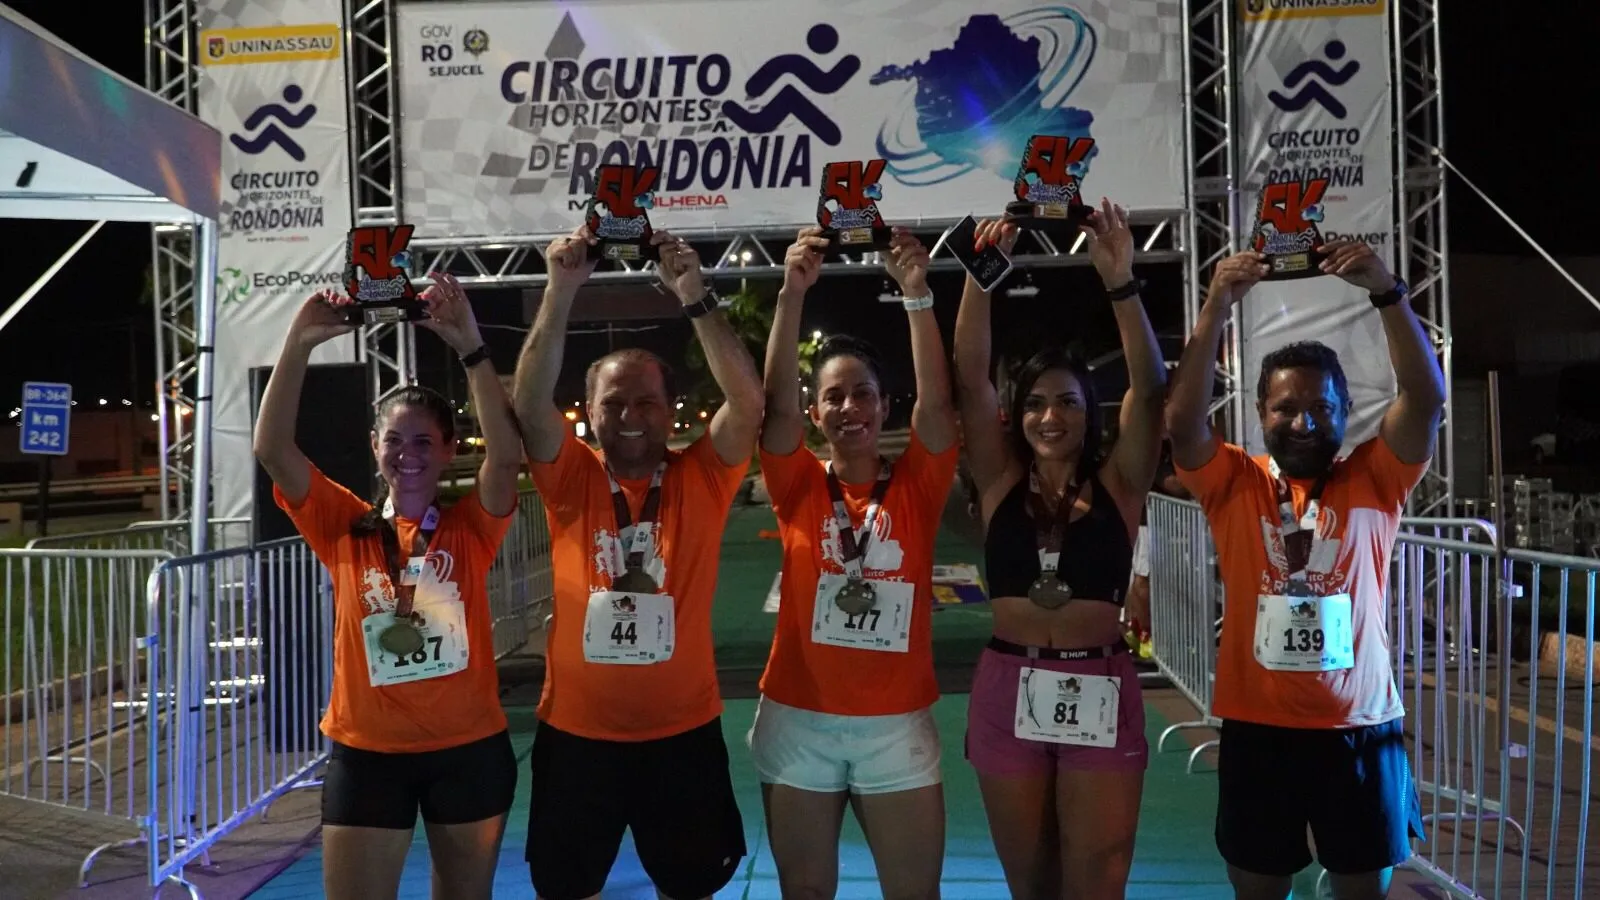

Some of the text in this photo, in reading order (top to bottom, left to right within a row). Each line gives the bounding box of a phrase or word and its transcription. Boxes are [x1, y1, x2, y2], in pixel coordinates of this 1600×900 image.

[420, 25, 453, 38] GOV
[229, 37, 333, 54] UNINASSAU
[421, 44, 453, 62] RO
[429, 65, 484, 77] SEJUCEL
[500, 53, 731, 104] CIRCUITO
[529, 98, 712, 127] HORIZONTES
[1267, 128, 1360, 148] CIRCUITO
[528, 140, 569, 172] DE
[1277, 148, 1351, 160] HORIZONTES
[231, 170, 319, 189] CIRCUITO
[653, 194, 728, 207] ILHENA
[27, 389, 68, 401] BR-364
[32, 411, 59, 425] km
[28, 430, 60, 446] 242
[844, 609, 881, 631] 177
[611, 622, 638, 645] 44
[1283, 628, 1325, 652] 139
[1053, 702, 1079, 725] 81
